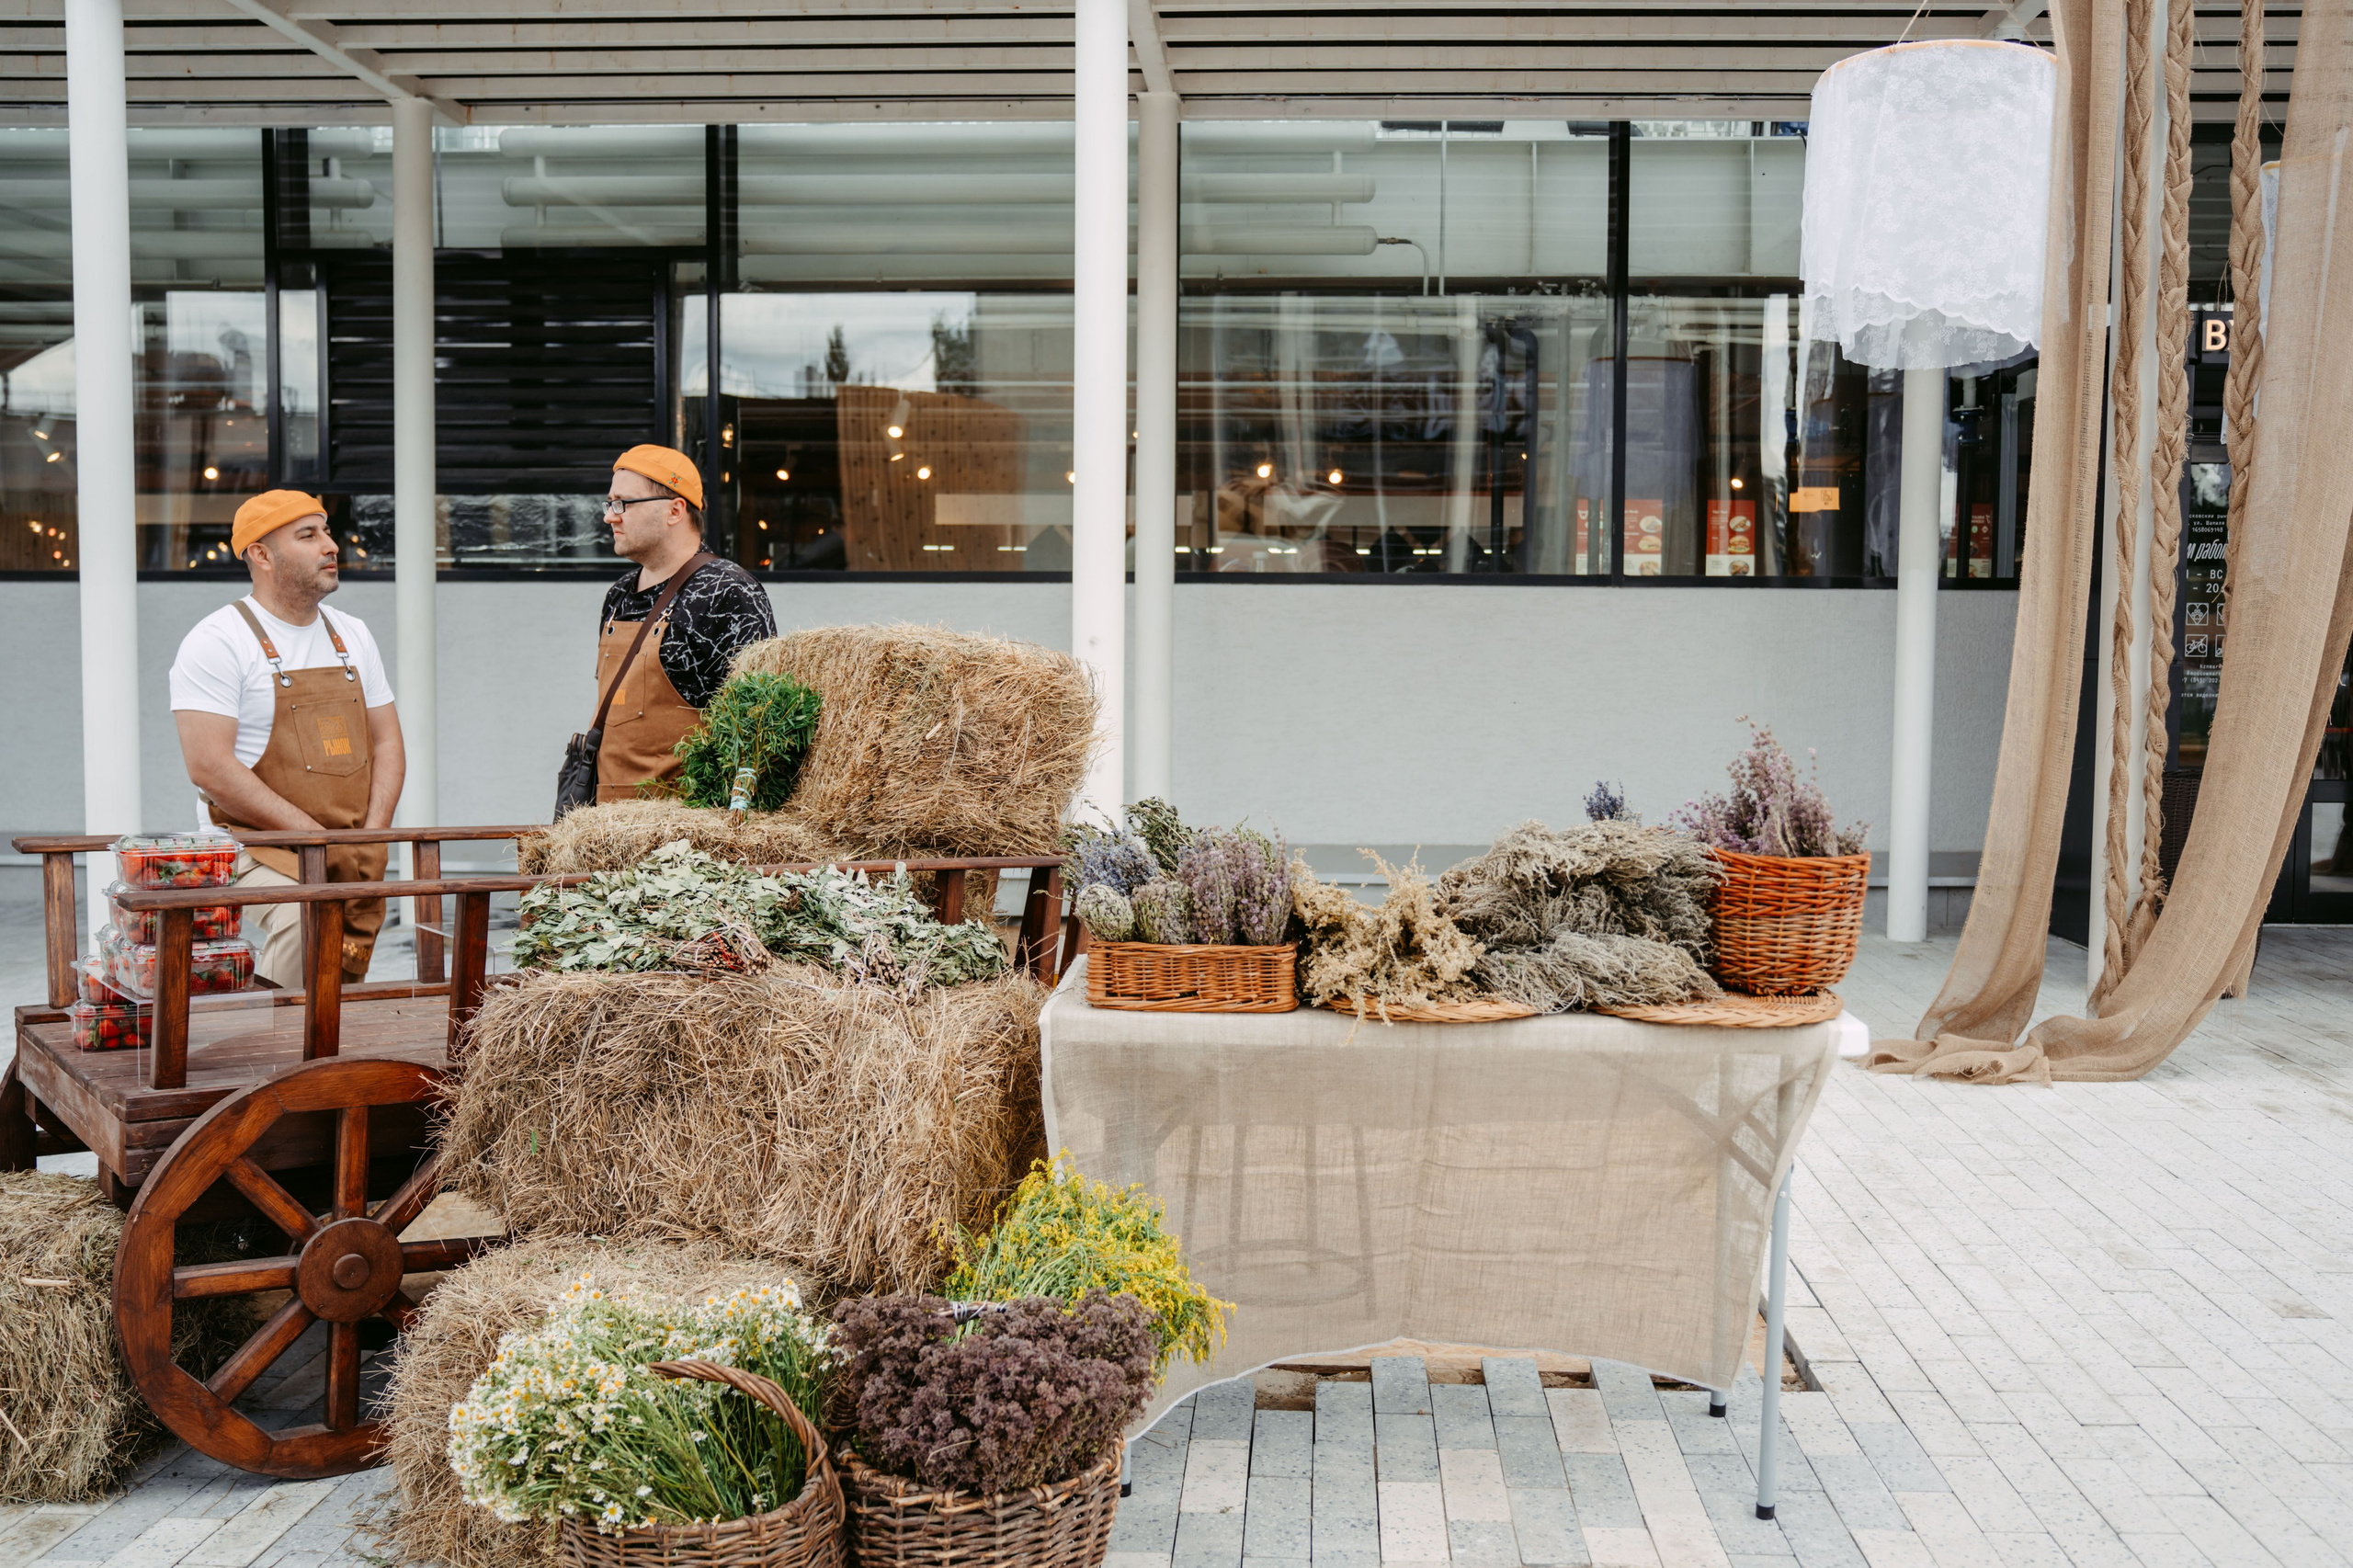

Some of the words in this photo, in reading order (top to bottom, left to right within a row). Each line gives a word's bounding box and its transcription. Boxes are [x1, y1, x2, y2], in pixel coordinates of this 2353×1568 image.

[2203, 319, 2234, 351] В
[2210, 569, 2223, 579] ВС
[323, 737, 352, 757] РЫНОК
